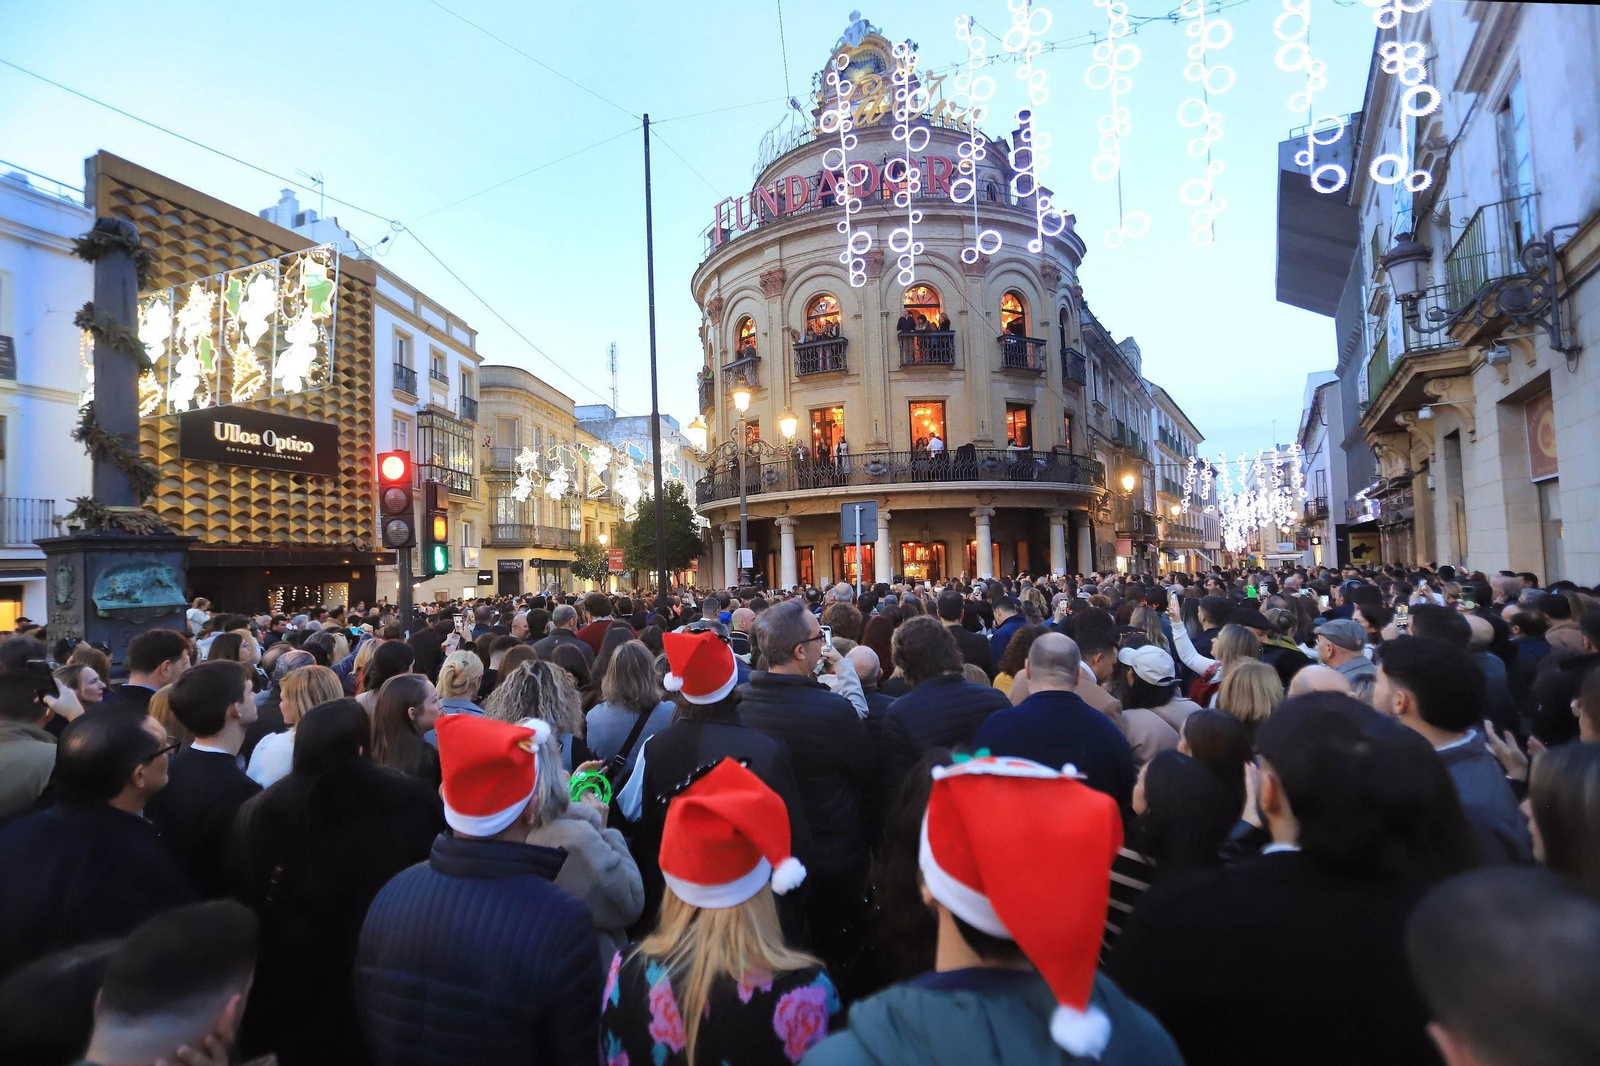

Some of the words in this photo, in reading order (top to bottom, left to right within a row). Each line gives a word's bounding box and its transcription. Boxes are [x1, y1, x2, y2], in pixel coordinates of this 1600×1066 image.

[713, 155, 963, 248] FUNDADOR
[213, 420, 262, 445] Ulloa
[263, 429, 315, 453] Optico
